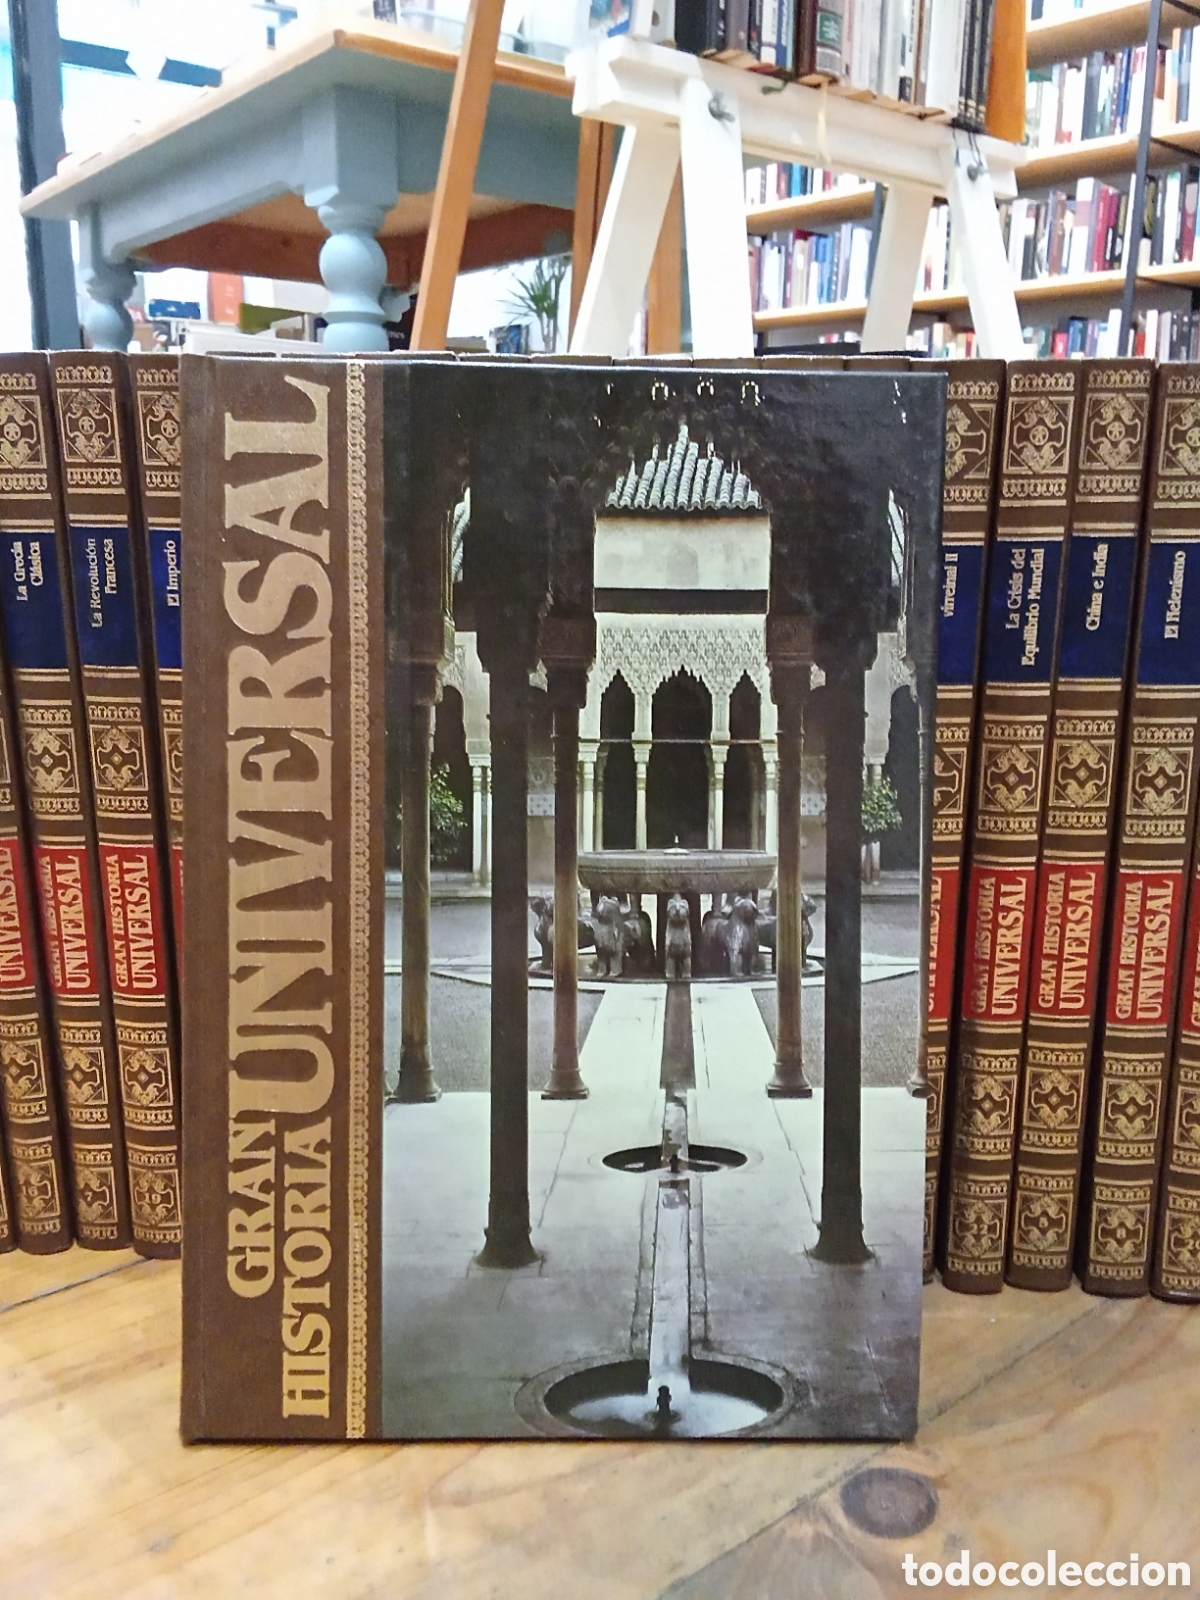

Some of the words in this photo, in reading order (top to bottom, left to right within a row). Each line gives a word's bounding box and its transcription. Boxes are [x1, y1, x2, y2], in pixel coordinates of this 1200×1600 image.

[86, 538, 101, 608] Revolución
[104, 538, 117, 594] Francesa
[164, 540, 180, 590] Imperio
[1012, 549, 1025, 568] del
[1028, 549, 1045, 599] Mundial
[1092, 544, 1108, 577] India
[1093, 579, 1105, 590] e
[17, 585, 28, 601] La
[92, 613, 102, 627] La
[1007, 574, 1023, 609] Crisis
[1086, 591, 1103, 631] China
[1006, 614, 1019, 629] La
[1022, 603, 1040, 665] Equilibrio
[222, 375, 335, 1118] UNIVERSAL
[55, 855, 91, 989] UNIVERSAL
[105, 854, 125, 936] HISTORIA
[123, 854, 158, 989] UNIVERSAL
[975, 877, 997, 961] HISTORIA
[1042, 872, 1066, 956] HISTORIA
[1119, 880, 1143, 966] HISTORIA
[112, 940, 129, 988] GRAN
[991, 877, 1027, 1016] UNIVERSAL
[1059, 872, 1097, 1011] UNIVERSAL
[1136, 879, 1175, 1020] UNIVERSAL
[1038, 959, 1057, 1009] GRAN
[1115, 968, 1136, 1019] GRAN
[227, 1119, 276, 1298] GRAN
[281, 1116, 333, 1419] HISTORIA
